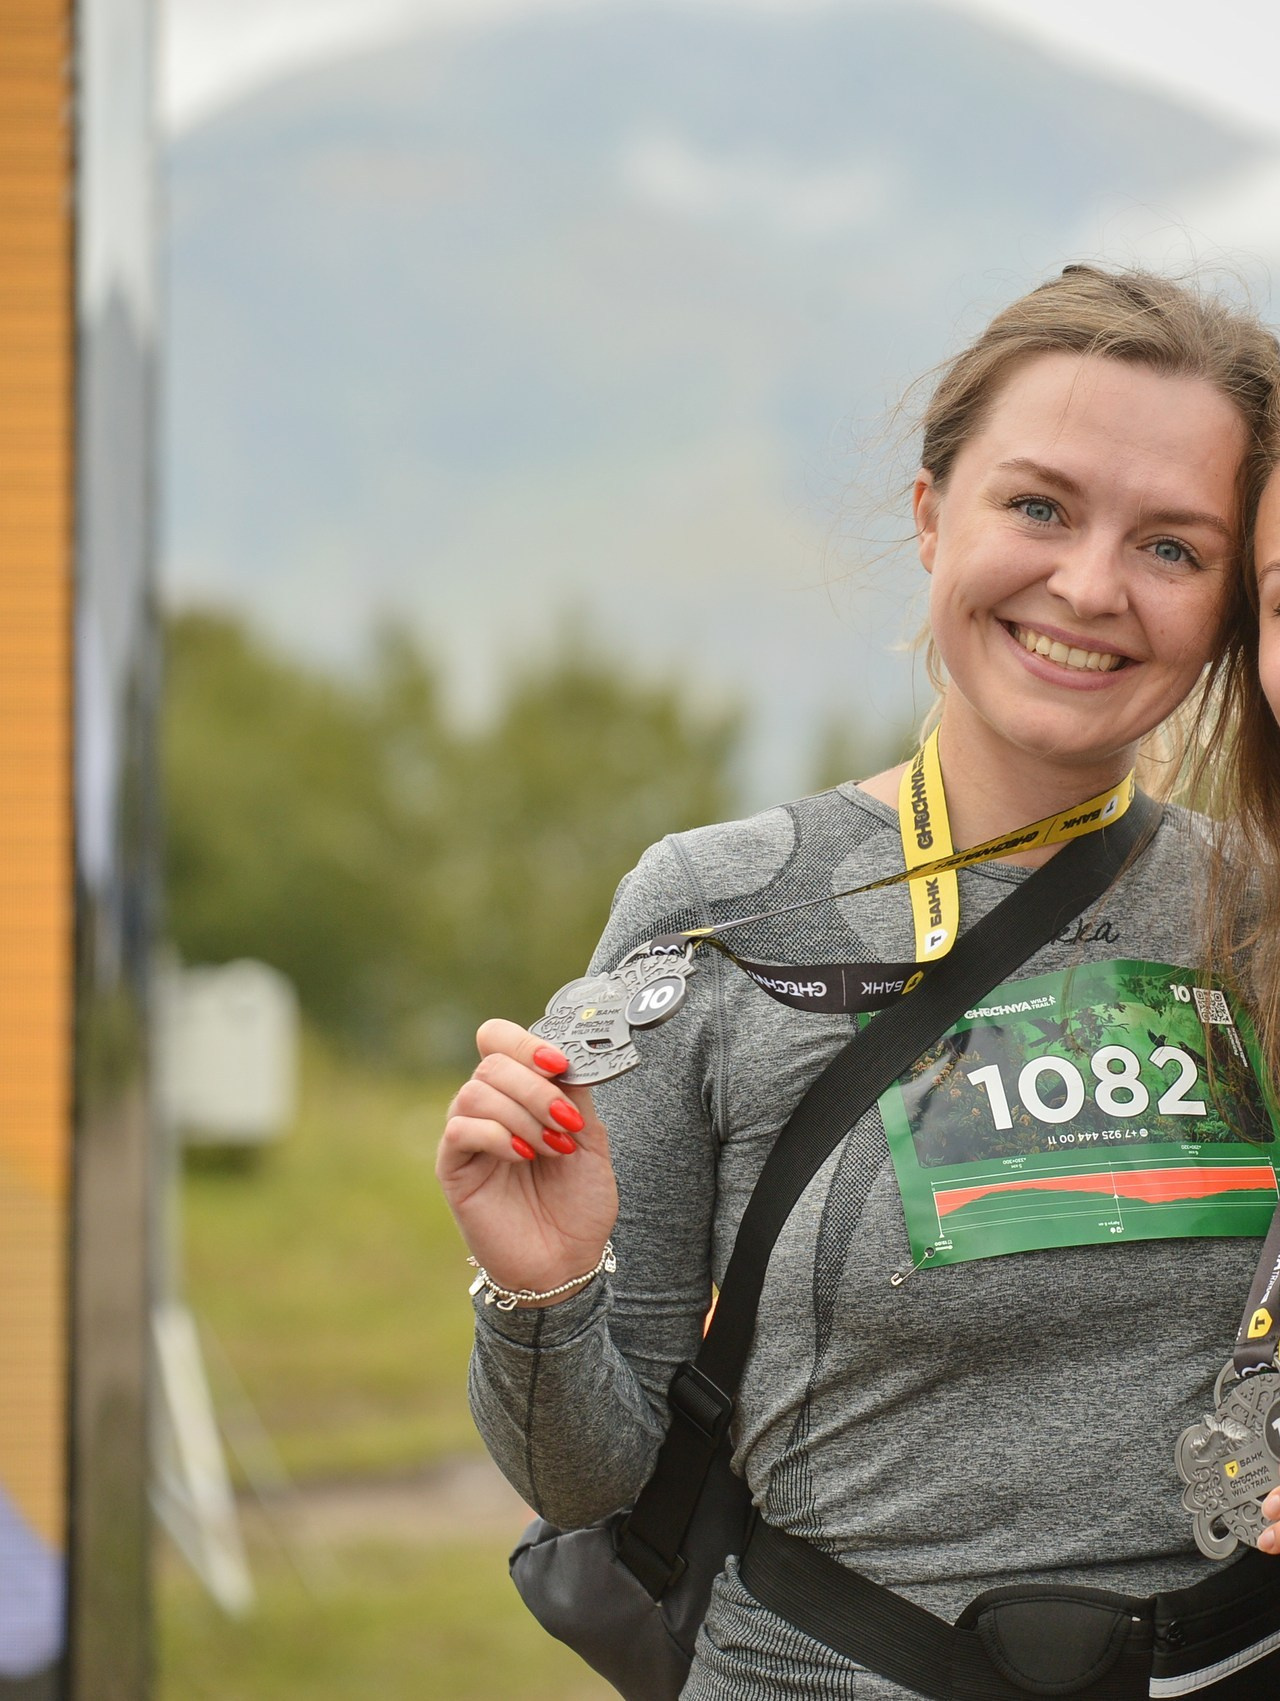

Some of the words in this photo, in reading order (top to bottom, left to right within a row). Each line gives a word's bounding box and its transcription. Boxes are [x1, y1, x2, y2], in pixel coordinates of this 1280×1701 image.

[1060, 807, 1102, 832] БАНК
[930, 877, 942, 928] БАНК
[746, 970, 828, 998] CHECHNY
[861, 979, 905, 994] БАНК
[638, 985, 675, 1011] 10
[1030, 997, 1048, 1005] WILD
[1169, 984, 1191, 1003] 10
[1032, 1002, 1051, 1010] TRAIL
[967, 1045, 1208, 1131] 1082
[1047, 1135, 1057, 1145] 11
[1059, 1134, 1075, 1143] 00
[1078, 1132, 1099, 1142] 444
[1102, 1130, 1122, 1140] 925
[1239, 1450, 1265, 1468] БАНК
[1231, 1486, 1251, 1498] WILD
[1250, 1476, 1273, 1489] TRAIL
